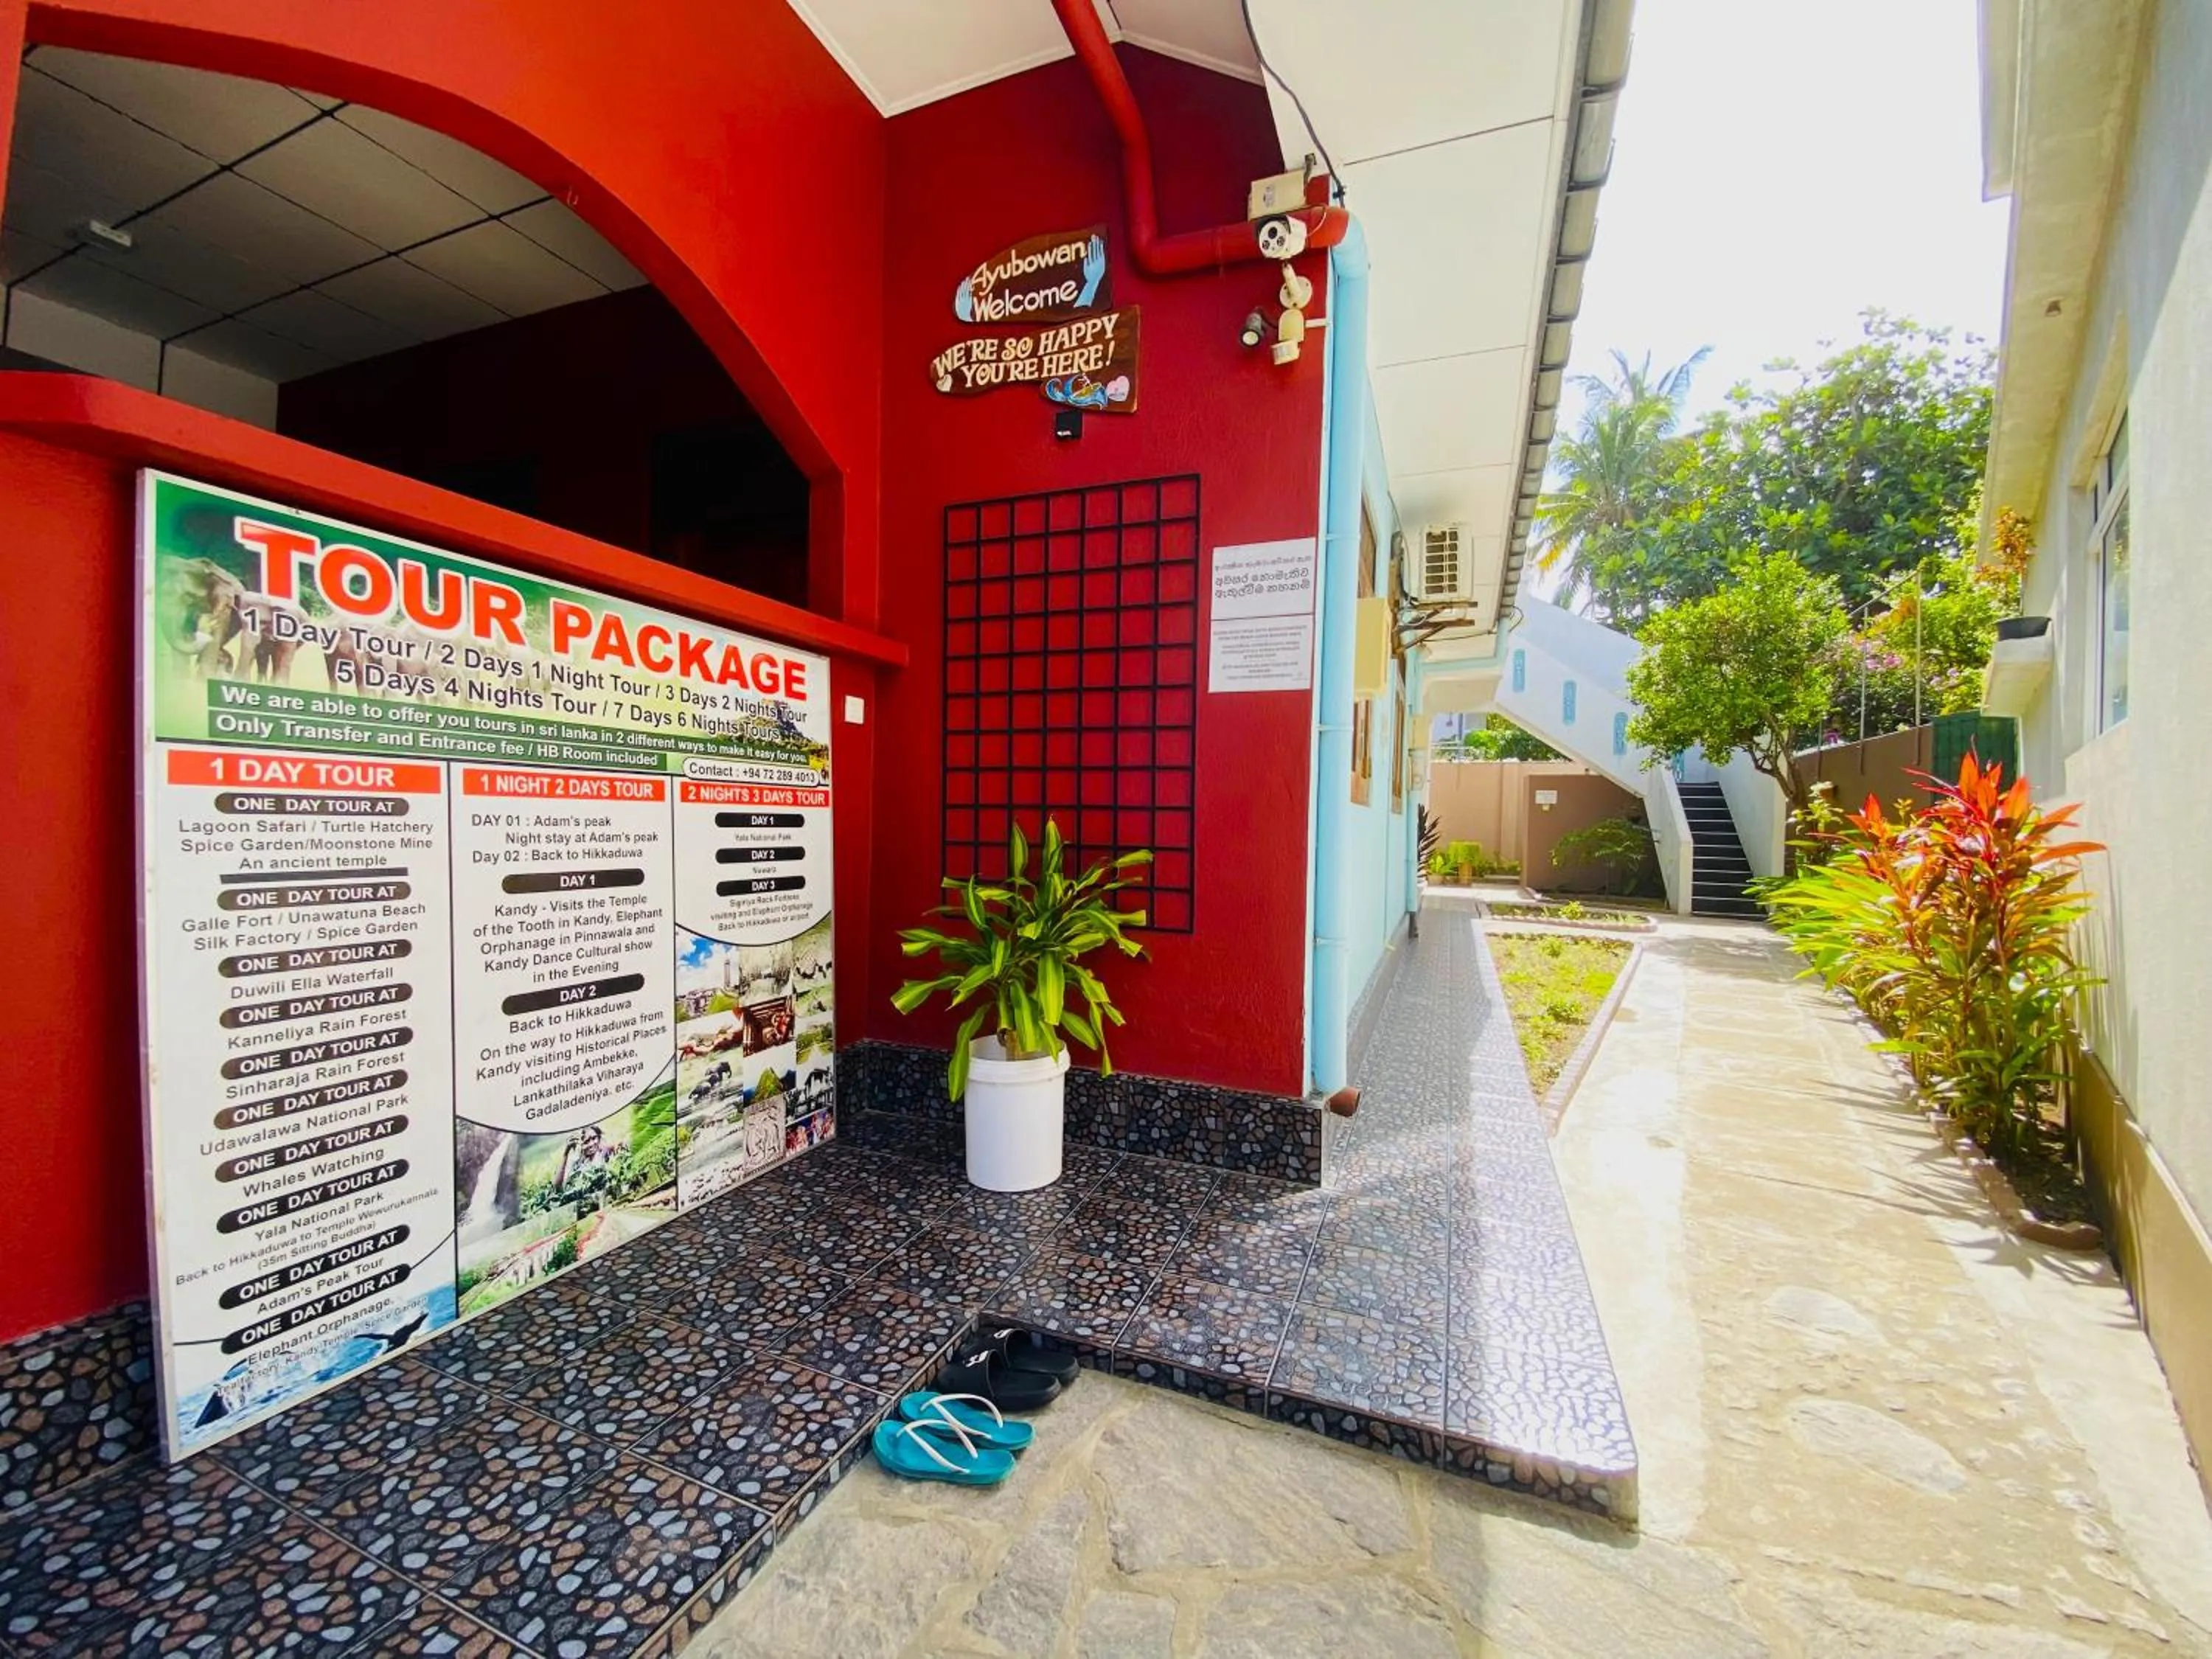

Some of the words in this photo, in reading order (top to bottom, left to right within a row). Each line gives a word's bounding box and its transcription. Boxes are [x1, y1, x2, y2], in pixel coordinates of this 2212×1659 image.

[970, 241, 1086, 295] Ayubowan
[973, 279, 1078, 321] Welcome
[933, 338, 998, 378] WE'RE
[1002, 337, 1033, 361] SO
[1038, 313, 1119, 355] HAPPY
[961, 358, 1038, 387] YOU'RE
[236, 518, 526, 647] TOUR
[549, 599, 807, 700] PACKAGE
[243, 609, 256, 633] 1
[274, 613, 338, 650] Day
[350, 627, 416, 659] Tour
[441, 644, 455, 664] 2
[465, 648, 523, 678] Days
[551, 667, 604, 691] Night
[611, 675, 650, 697] Tour
[681, 688, 717, 710] Days
[735, 698, 776, 720] Nights
[336, 661, 353, 684] 5
[445, 681, 460, 697] 4
[467, 683, 543, 709] Nights
[692, 714, 737, 737] Nights
[743, 723, 779, 740] Tours
[222, 686, 260, 707] We
[268, 694, 304, 710] are
[311, 697, 357, 717] able
[362, 703, 382, 719] to
[388, 706, 431, 724] offer
[438, 713, 470, 730] you
[475, 717, 517, 732] tours
[521, 721, 534, 734] in
[539, 724, 557, 737] sri
[562, 726, 597, 742] lanka
[601, 730, 613, 742] in
[627, 732, 675, 749] different
[678, 740, 704, 755] ways
[707, 742, 717, 754] to
[720, 742, 745, 757] make
[755, 749, 773, 761] easy
[776, 750, 788, 760] for
[217, 715, 273, 737] Only
[281, 720, 371, 743] Transfer
[378, 728, 413, 746] and
[419, 731, 495, 753] Entrance
[501, 742, 524, 756] fee
[538, 745, 558, 758] HB
[563, 748, 602, 761] Room
[606, 751, 658, 765] included
[210, 759, 223, 779] 1
[240, 759, 305, 783] DAY
[314, 763, 394, 787] TOUR
[689, 762, 733, 777] Contact
[742, 768, 759, 779] +94
[763, 771, 775, 780] 72
[496, 777, 551, 794] NIGHT
[568, 781, 610, 796] DAYS
[614, 783, 654, 797] TOUR
[701, 788, 749, 801] NIGHTS
[763, 791, 793, 803] DAYS
[234, 797, 276, 810] ONE
[286, 799, 321, 811] DAY
[325, 800, 370, 812] TOUR
[376, 801, 394, 813] AT
[179, 820, 249, 837] Lagoon
[257, 820, 306, 833] Safari
[322, 821, 365, 832] Turtle
[371, 821, 433, 835] Hatchery
[534, 815, 580, 827] Adam's
[585, 817, 611, 829] peak
[181, 839, 233, 854] Spice
[400, 838, 432, 849] Mine
[506, 833, 541, 846] Night
[545, 834, 571, 845] stay
[590, 832, 630, 842] Adam's
[634, 832, 658, 844] peak
[240, 858, 264, 869] An
[270, 856, 330, 869] ancient
[337, 855, 386, 868] temple
[473, 852, 499, 865] Day
[532, 849, 562, 860] Back
[582, 848, 643, 858] Hikkaduwa
[183, 918, 230, 931] Galle
[237, 915, 272, 928] Fort
[289, 908, 377, 924] Unawatuna
[383, 904, 425, 917] Beach
[495, 904, 537, 917] Kandy
[550, 900, 583, 912] Visits
[588, 898, 605, 908] the
[609, 894, 647, 907] Temple
[194, 936, 227, 950] Silk
[236, 931, 300, 947] Factory
[318, 925, 361, 941] Spice
[366, 921, 417, 934] Garden
[473, 925, 488, 937] of
[493, 923, 513, 934] the
[518, 919, 554, 932] Tooth
[617, 908, 663, 923] Elephant
[481, 936, 555, 956] Orphanage
[575, 928, 632, 942] Pinnawala
[636, 924, 655, 935] and
[484, 957, 528, 973] Kandy
[534, 951, 573, 965] Dance
[577, 945, 621, 959] Cultural
[625, 940, 653, 952] show
[573, 961, 619, 976] Evening
[231, 981, 285, 998] Duwili
[292, 978, 321, 990] Ella
[327, 967, 393, 985] Waterfall
[566, 999, 632, 1022] Hikkaduwa
[228, 1025, 313, 1049] Kanneliya
[321, 1019, 355, 1034] Rain
[361, 1010, 406, 1026] Forest
[481, 1048, 501, 1061] On
[531, 1037, 555, 1050] way
[576, 1017, 636, 1038] Hikkaduwa
[640, 1010, 664, 1023] from
[476, 1061, 521, 1081] Kandy
[526, 1048, 571, 1068] visiting
[576, 1034, 629, 1054] Historical
[633, 1026, 667, 1040] Places
[227, 1072, 309, 1099] Sinharaja
[316, 1062, 351, 1081] Rain
[358, 1052, 404, 1071] Forest
[514, 1076, 594, 1107] Lankathilaka
[597, 1060, 644, 1083] Viharaya
[521, 1063, 580, 1087] including
[201, 1121, 300, 1155] Udawalawa
[307, 1105, 370, 1128] National
[377, 1094, 408, 1110] Park
[244, 1172, 306, 1197] Whales
[313, 1149, 384, 1176] Watching
[255, 1220, 287, 1241] Yala
[292, 1203, 349, 1228] National
[355, 1192, 383, 1208] Park
[176, 1267, 208, 1285] Back
[230, 1238, 296, 1267] Hikkaduwa
[257, 1286, 312, 1314] Adam's
[317, 1272, 349, 1290] Peak
[248, 1337, 313, 1365] Elephant
